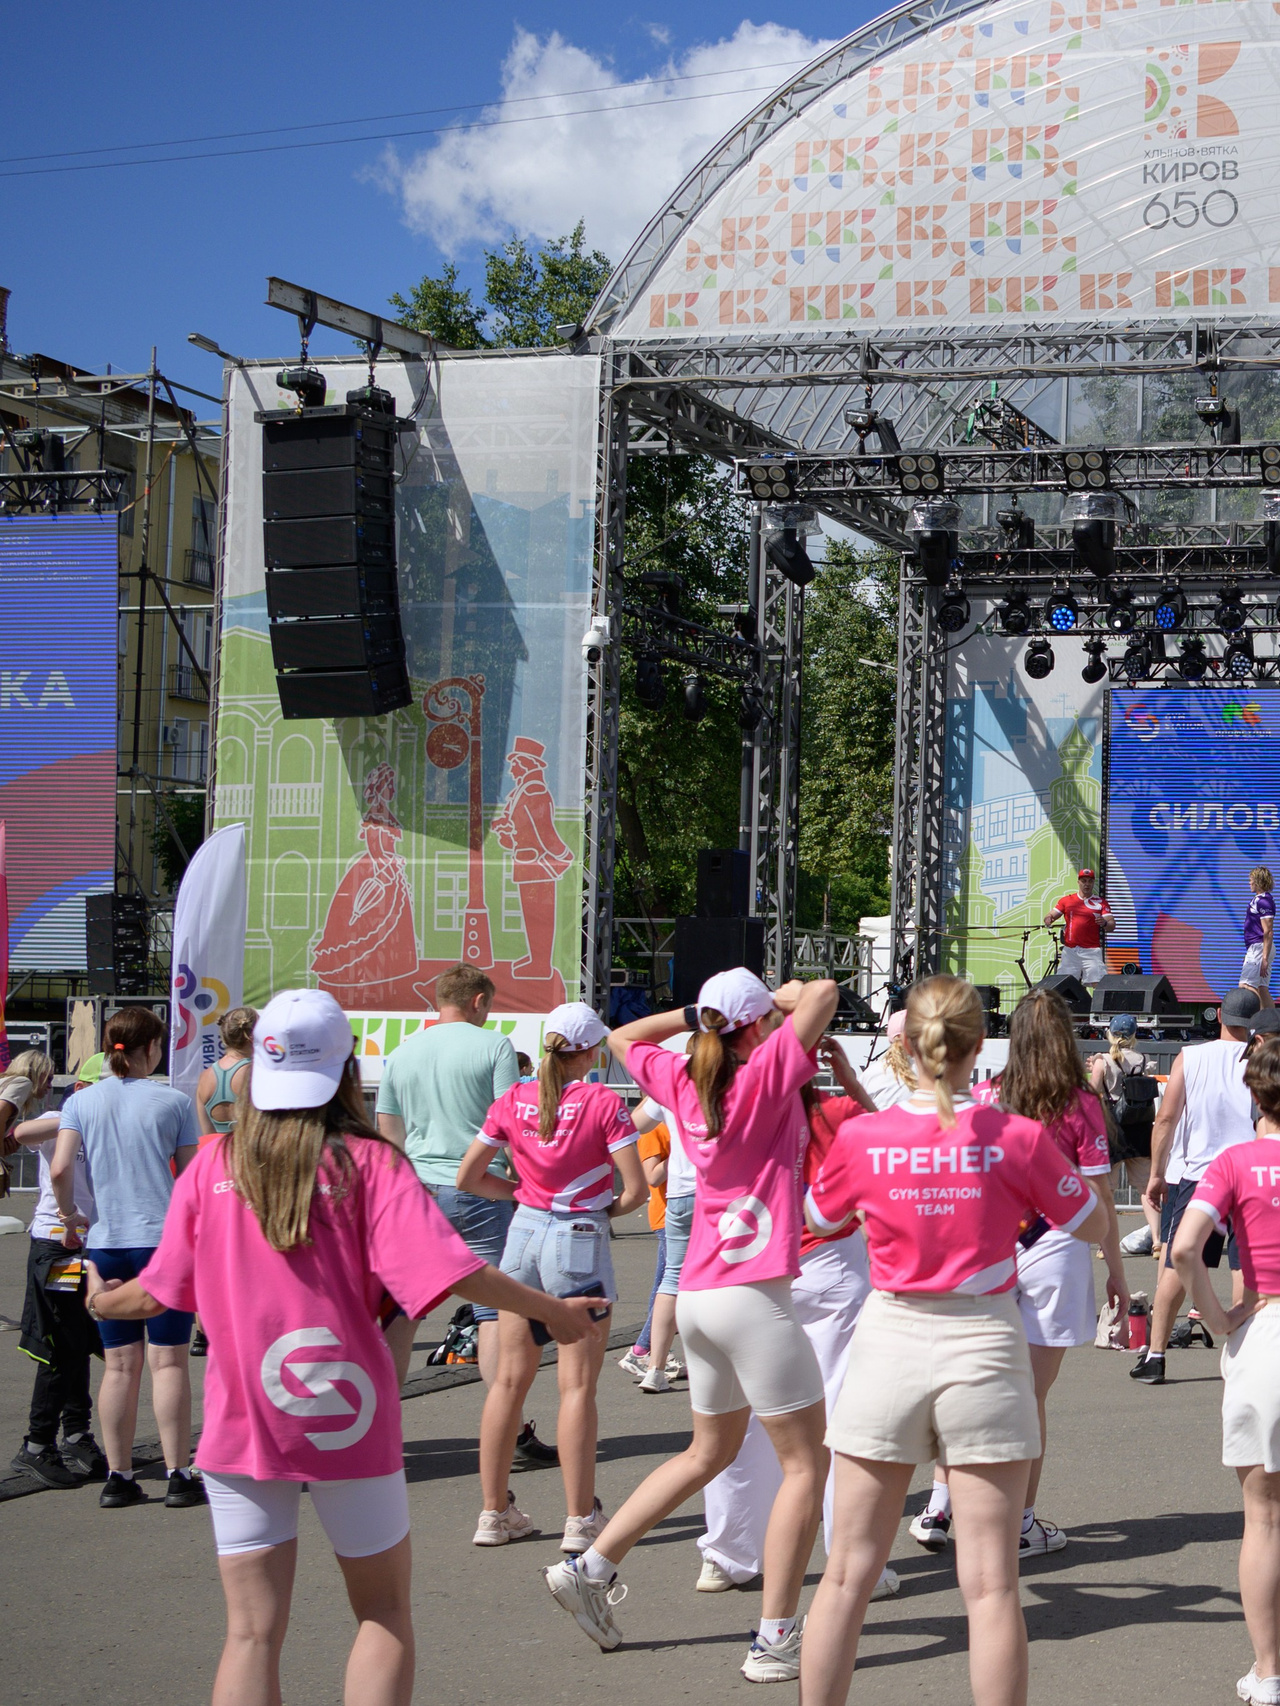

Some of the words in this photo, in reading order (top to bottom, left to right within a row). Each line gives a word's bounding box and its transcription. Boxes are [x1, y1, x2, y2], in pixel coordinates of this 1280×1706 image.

[1143, 160, 1240, 185] КИРОВ
[1142, 189, 1239, 230] 650
[866, 1146, 1005, 1175] ТРЕНЕР
[888, 1187, 920, 1201] GYM
[921, 1186, 982, 1200] STATION
[915, 1203, 955, 1216] TEAM
